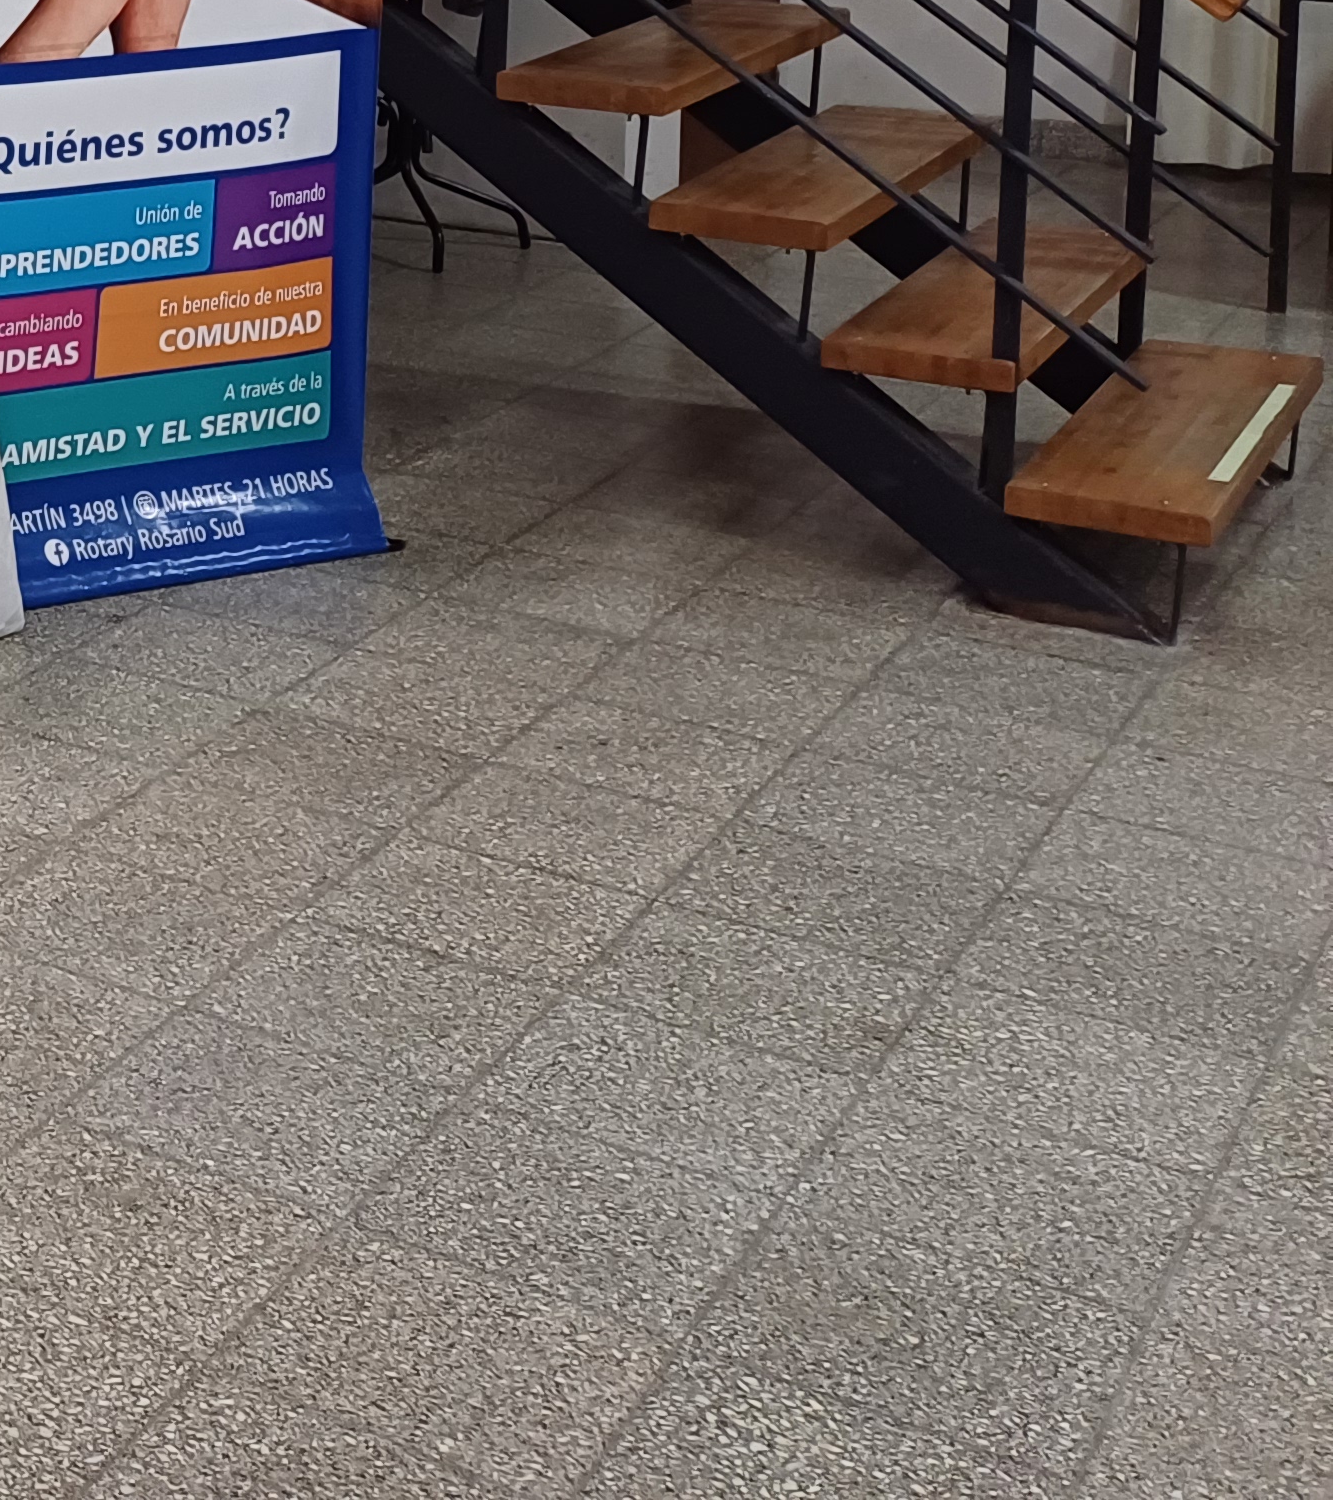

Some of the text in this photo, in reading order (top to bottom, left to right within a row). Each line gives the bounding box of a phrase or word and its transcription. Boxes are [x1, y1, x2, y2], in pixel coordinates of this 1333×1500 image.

[156, 106, 291, 154] somos?
[135, 202, 203, 227] Unión de
[269, 183, 326, 210] Tomando
[232, 213, 325, 252] ACCIÓN
[159, 280, 324, 318] En beneficio de nuestra
[158, 309, 323, 353] COMUNIDAD
[223, 371, 323, 401] A través de la
[1, 402, 321, 468] AMISTAD Y EL SERVICIO
[10, 502, 67, 535] ARTÍN
[69, 498, 119, 527] 3498
[242, 478, 266, 500] 21
[269, 467, 334, 498] HORAS
[72, 512, 246, 561] Rotary Rosario Sud
